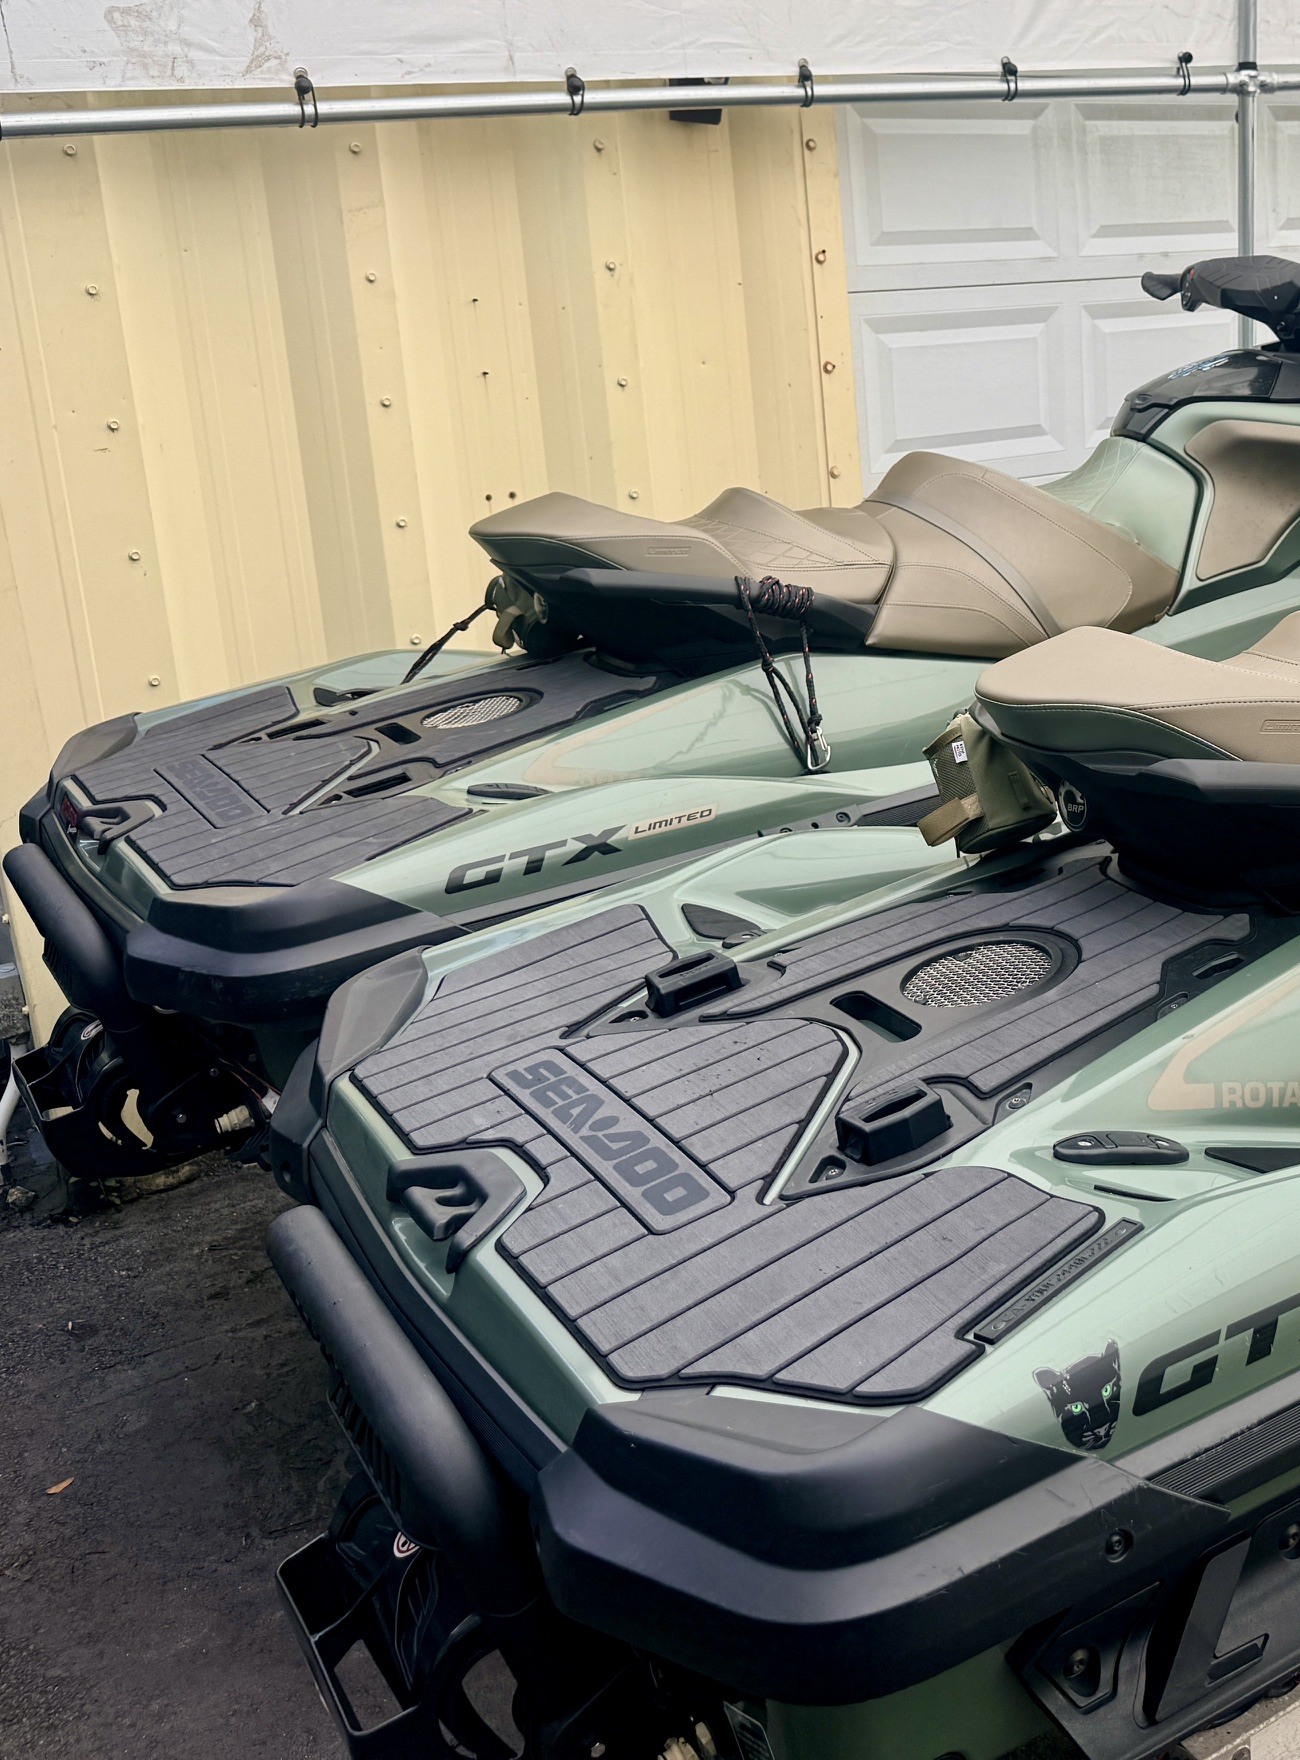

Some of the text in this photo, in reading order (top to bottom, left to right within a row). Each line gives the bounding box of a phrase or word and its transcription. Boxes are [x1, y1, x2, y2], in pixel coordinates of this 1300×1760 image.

[1067, 803, 1085, 814] BRP
[444, 808, 713, 894] GTX LIMITED
